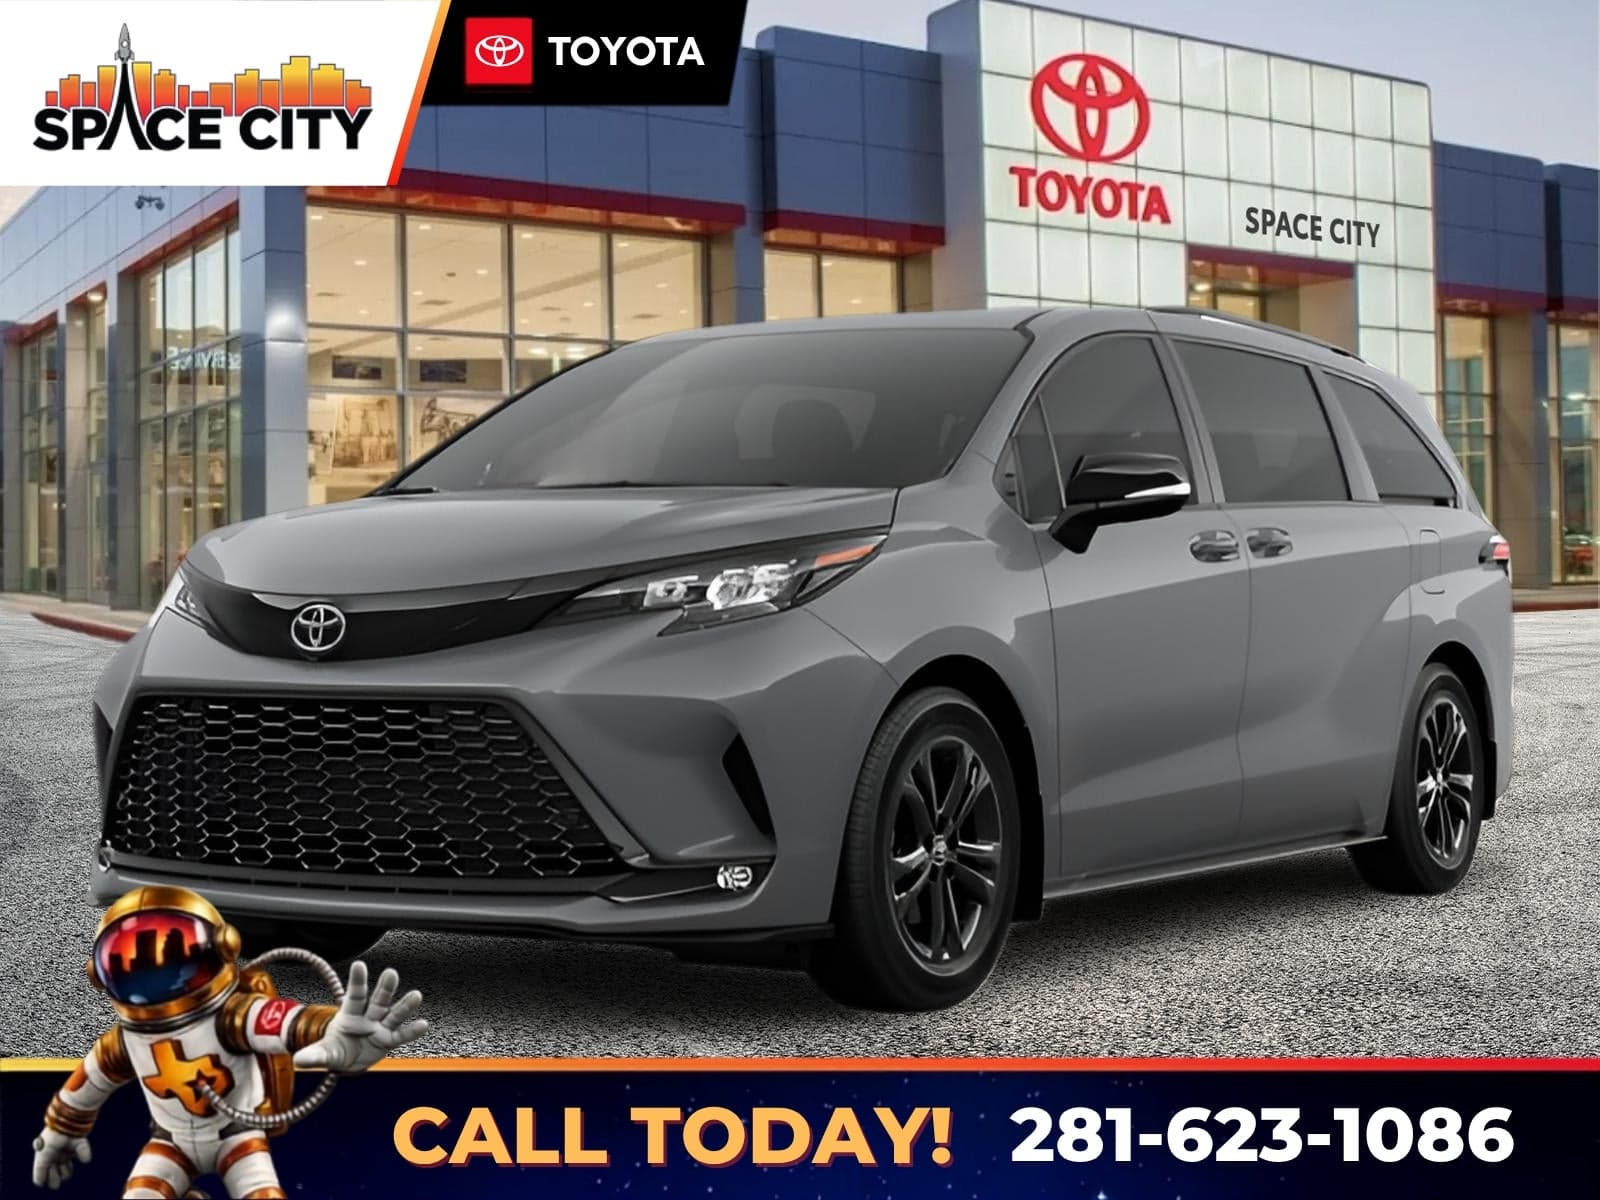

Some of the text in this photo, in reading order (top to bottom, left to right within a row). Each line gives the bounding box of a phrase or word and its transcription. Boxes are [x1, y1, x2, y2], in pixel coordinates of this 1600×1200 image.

[1009, 166, 1170, 224] TOYOTA
[1245, 206, 1381, 249] SPACE CITY
